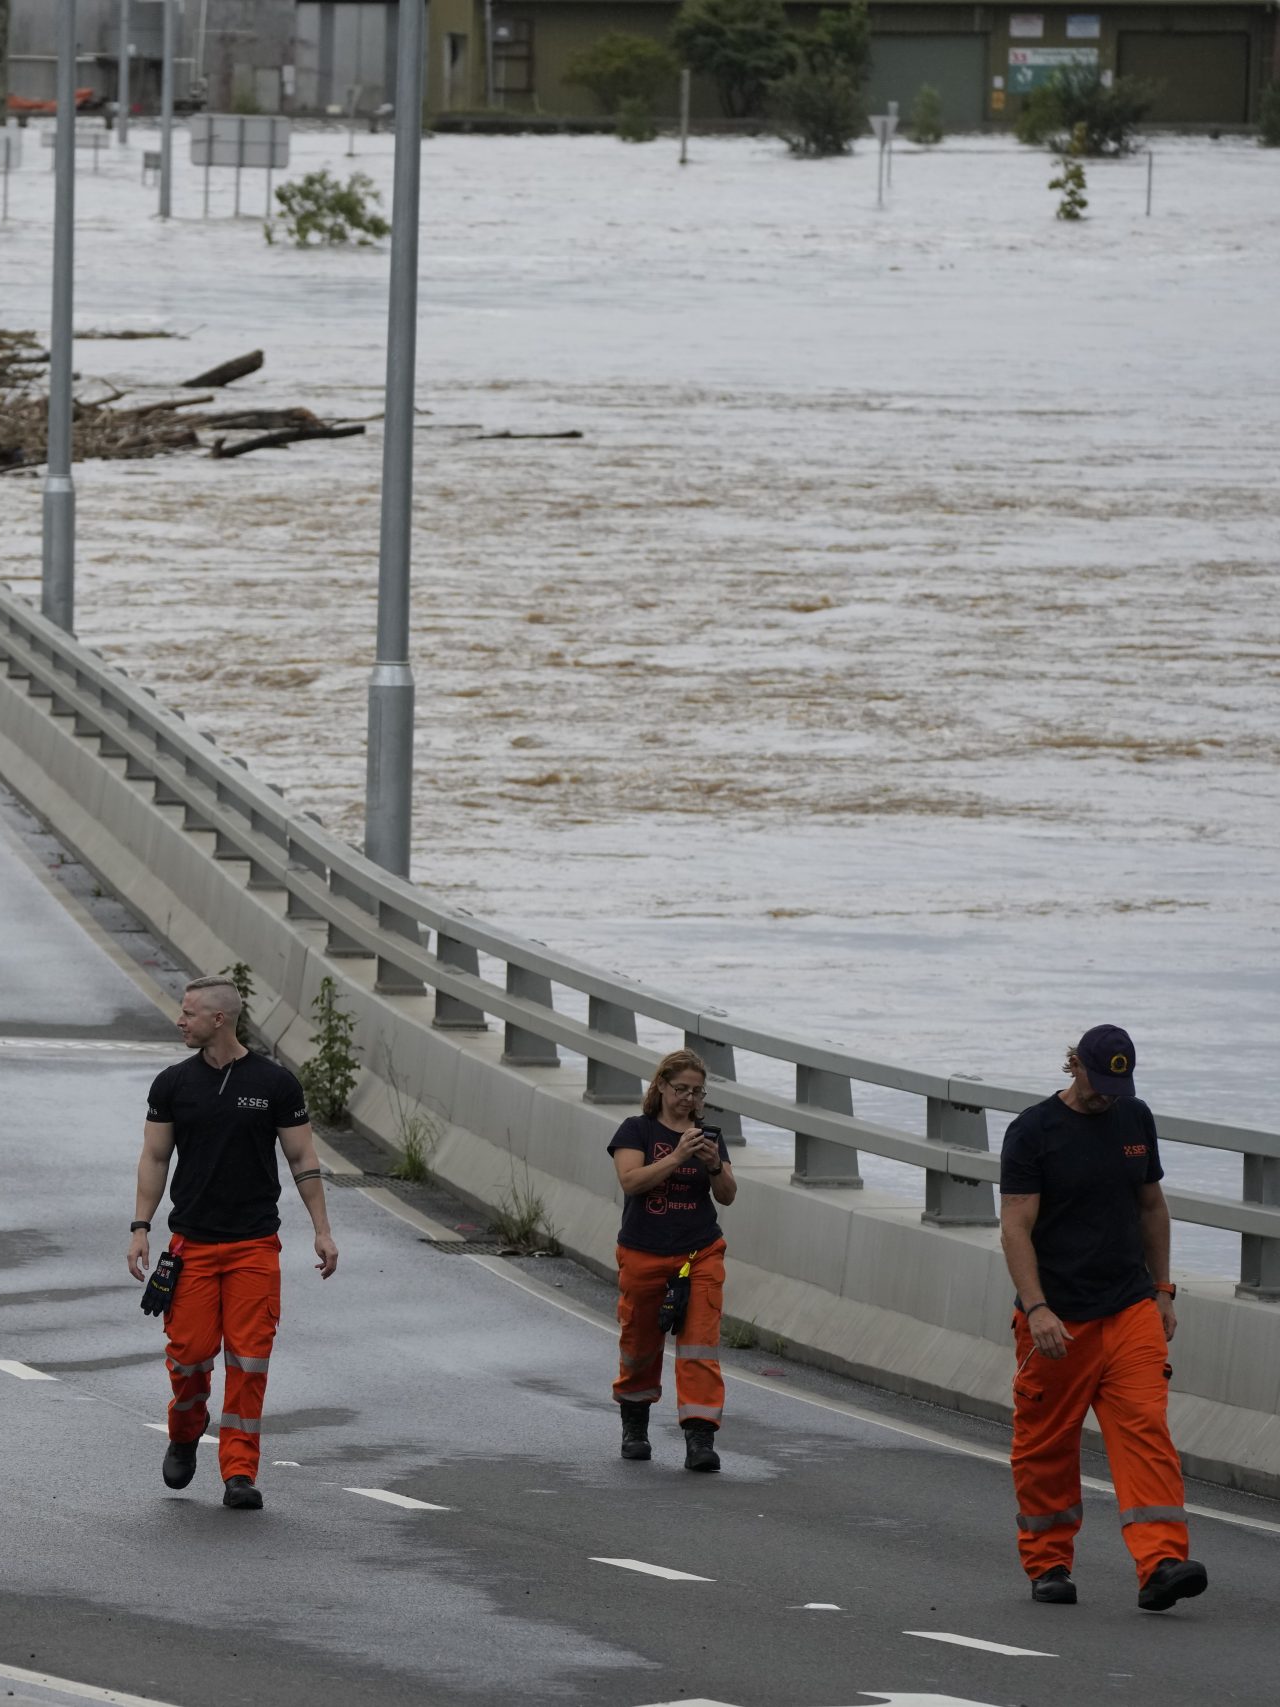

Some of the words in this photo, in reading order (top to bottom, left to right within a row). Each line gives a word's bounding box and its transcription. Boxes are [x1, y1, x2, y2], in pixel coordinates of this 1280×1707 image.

[249, 1098, 269, 1108] SES
[1132, 1145, 1147, 1154] SES
[668, 1201, 697, 1210] REPEAT
